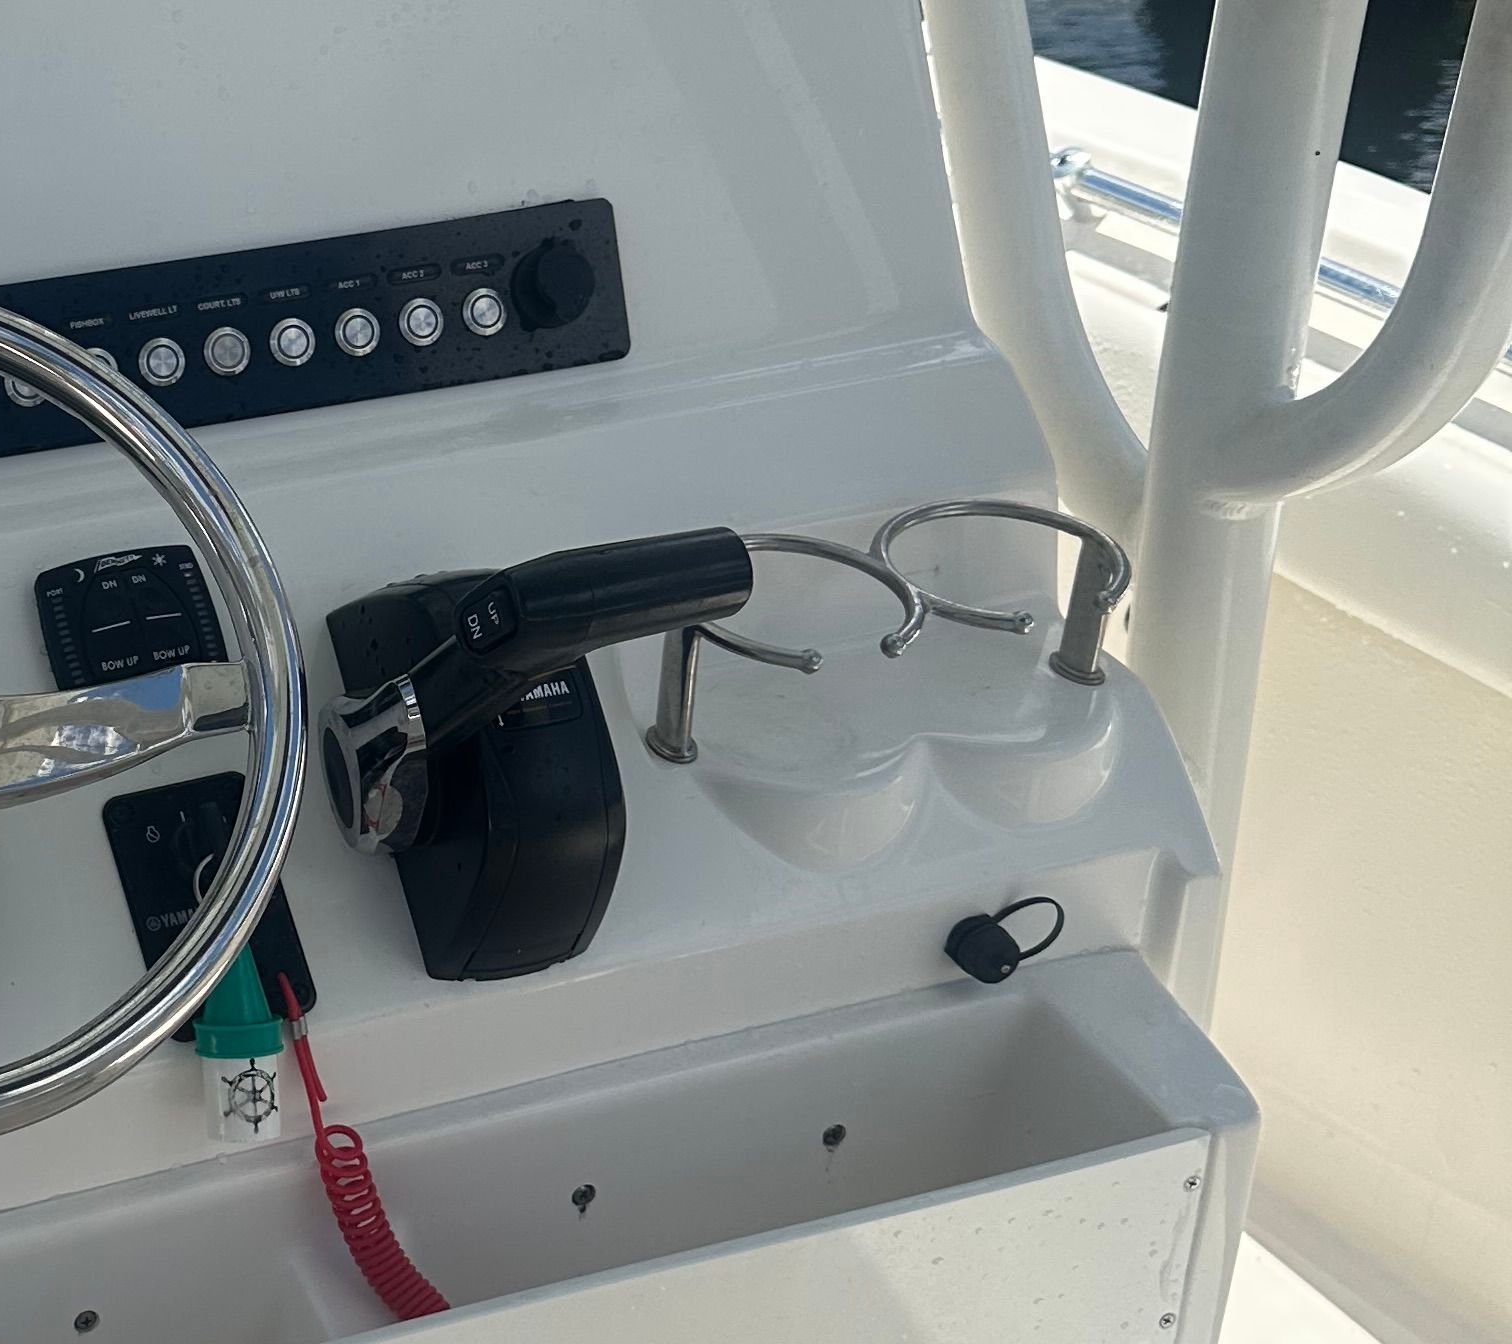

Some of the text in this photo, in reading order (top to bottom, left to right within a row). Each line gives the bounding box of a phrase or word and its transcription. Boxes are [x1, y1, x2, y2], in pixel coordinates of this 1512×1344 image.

[465, 261, 482, 270] ACC
[402, 272, 418, 280] ACC
[338, 281, 354, 289] ACC
[131, 574, 147, 585] DN
[101, 580, 118, 591] DN
[46, 588, 64, 598] PORT
[487, 601, 500, 625] UP
[467, 613, 483, 640] DN
[153, 645, 191, 662] BOW UP
[101, 656, 140, 672] BOW UP
[520, 680, 570, 702] AMAHA
